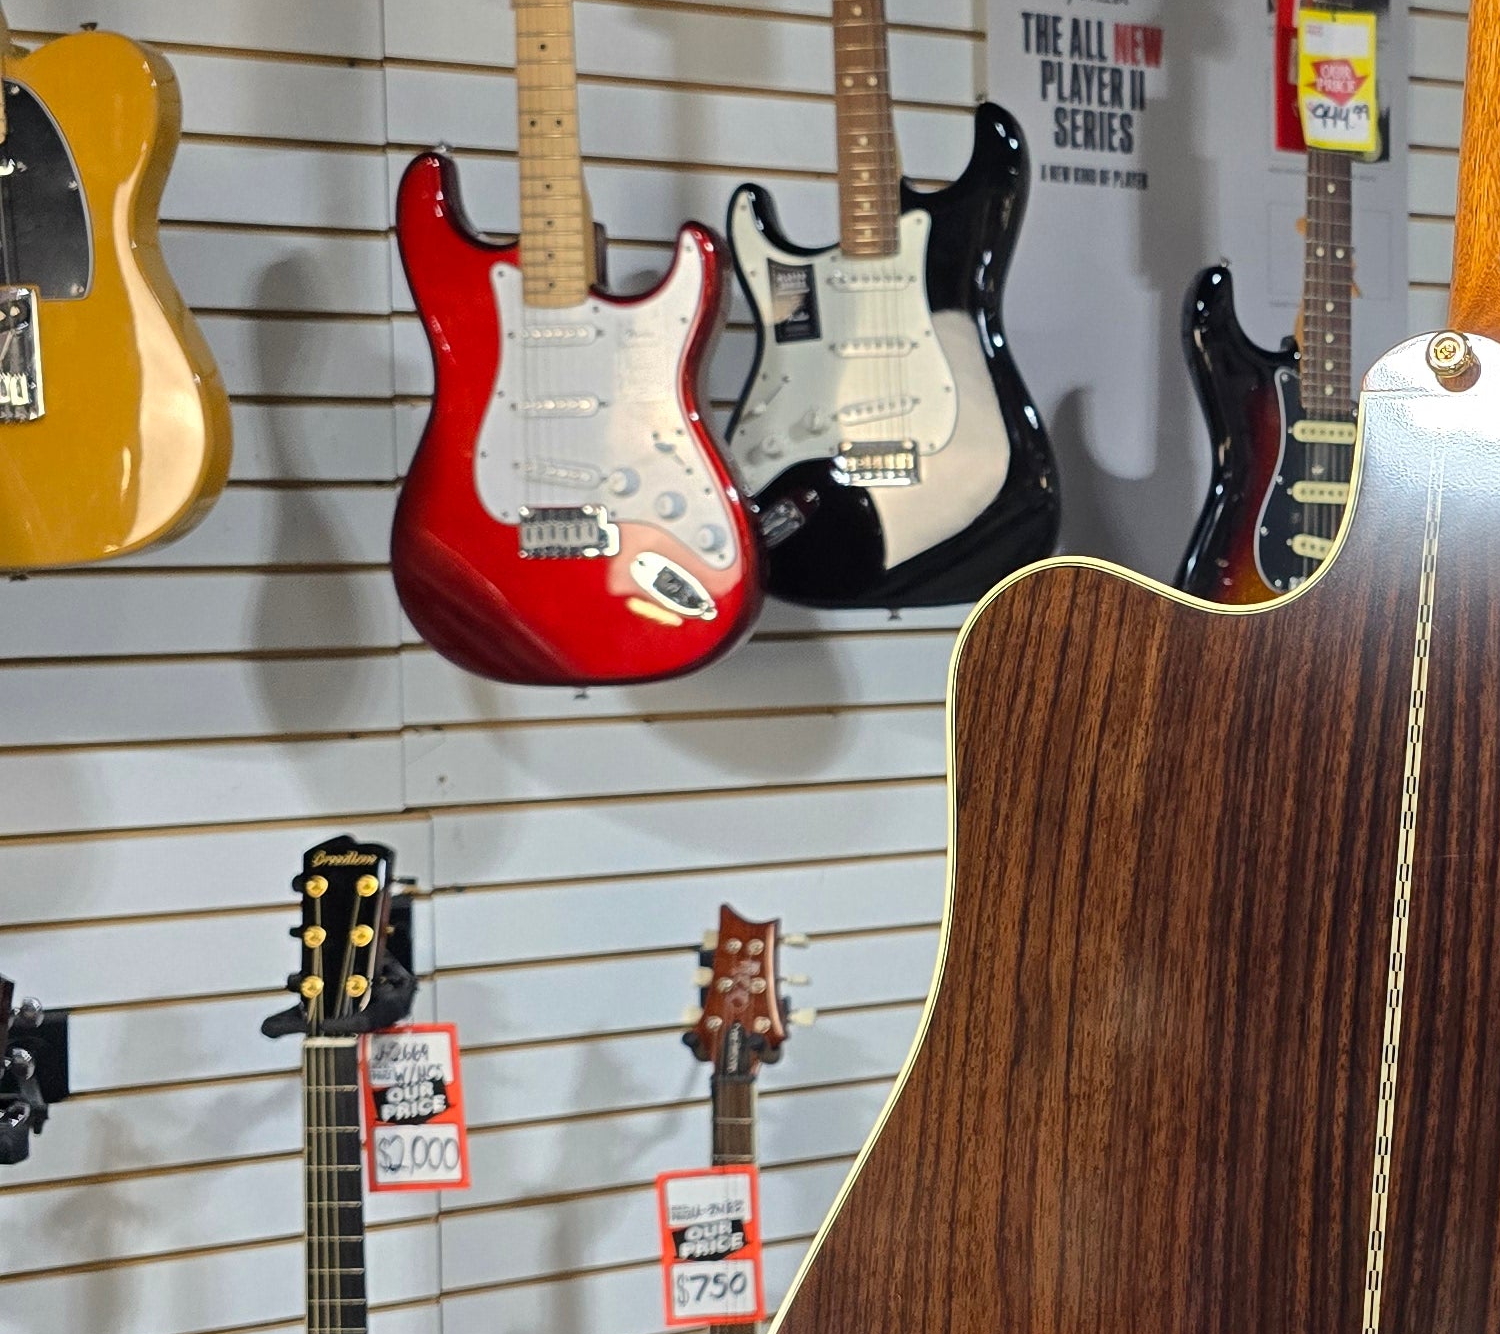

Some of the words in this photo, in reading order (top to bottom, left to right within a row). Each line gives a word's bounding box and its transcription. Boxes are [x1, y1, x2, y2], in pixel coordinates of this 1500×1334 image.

[1021, 12, 1063, 58] THE
[1069, 18, 1107, 62] ALL
[1113, 21, 1164, 68] NEW
[1041, 60, 1123, 109] PLAYER
[1130, 70, 1146, 111] II
[1054, 106, 1134, 154] SERIES
[380, 1094, 447, 1123] PRICE
[386, 1081, 434, 1104] OUR
[678, 1231, 745, 1260] PRICE
[684, 1220, 733, 1242] OUR
[677, 1271, 748, 1308] $750
